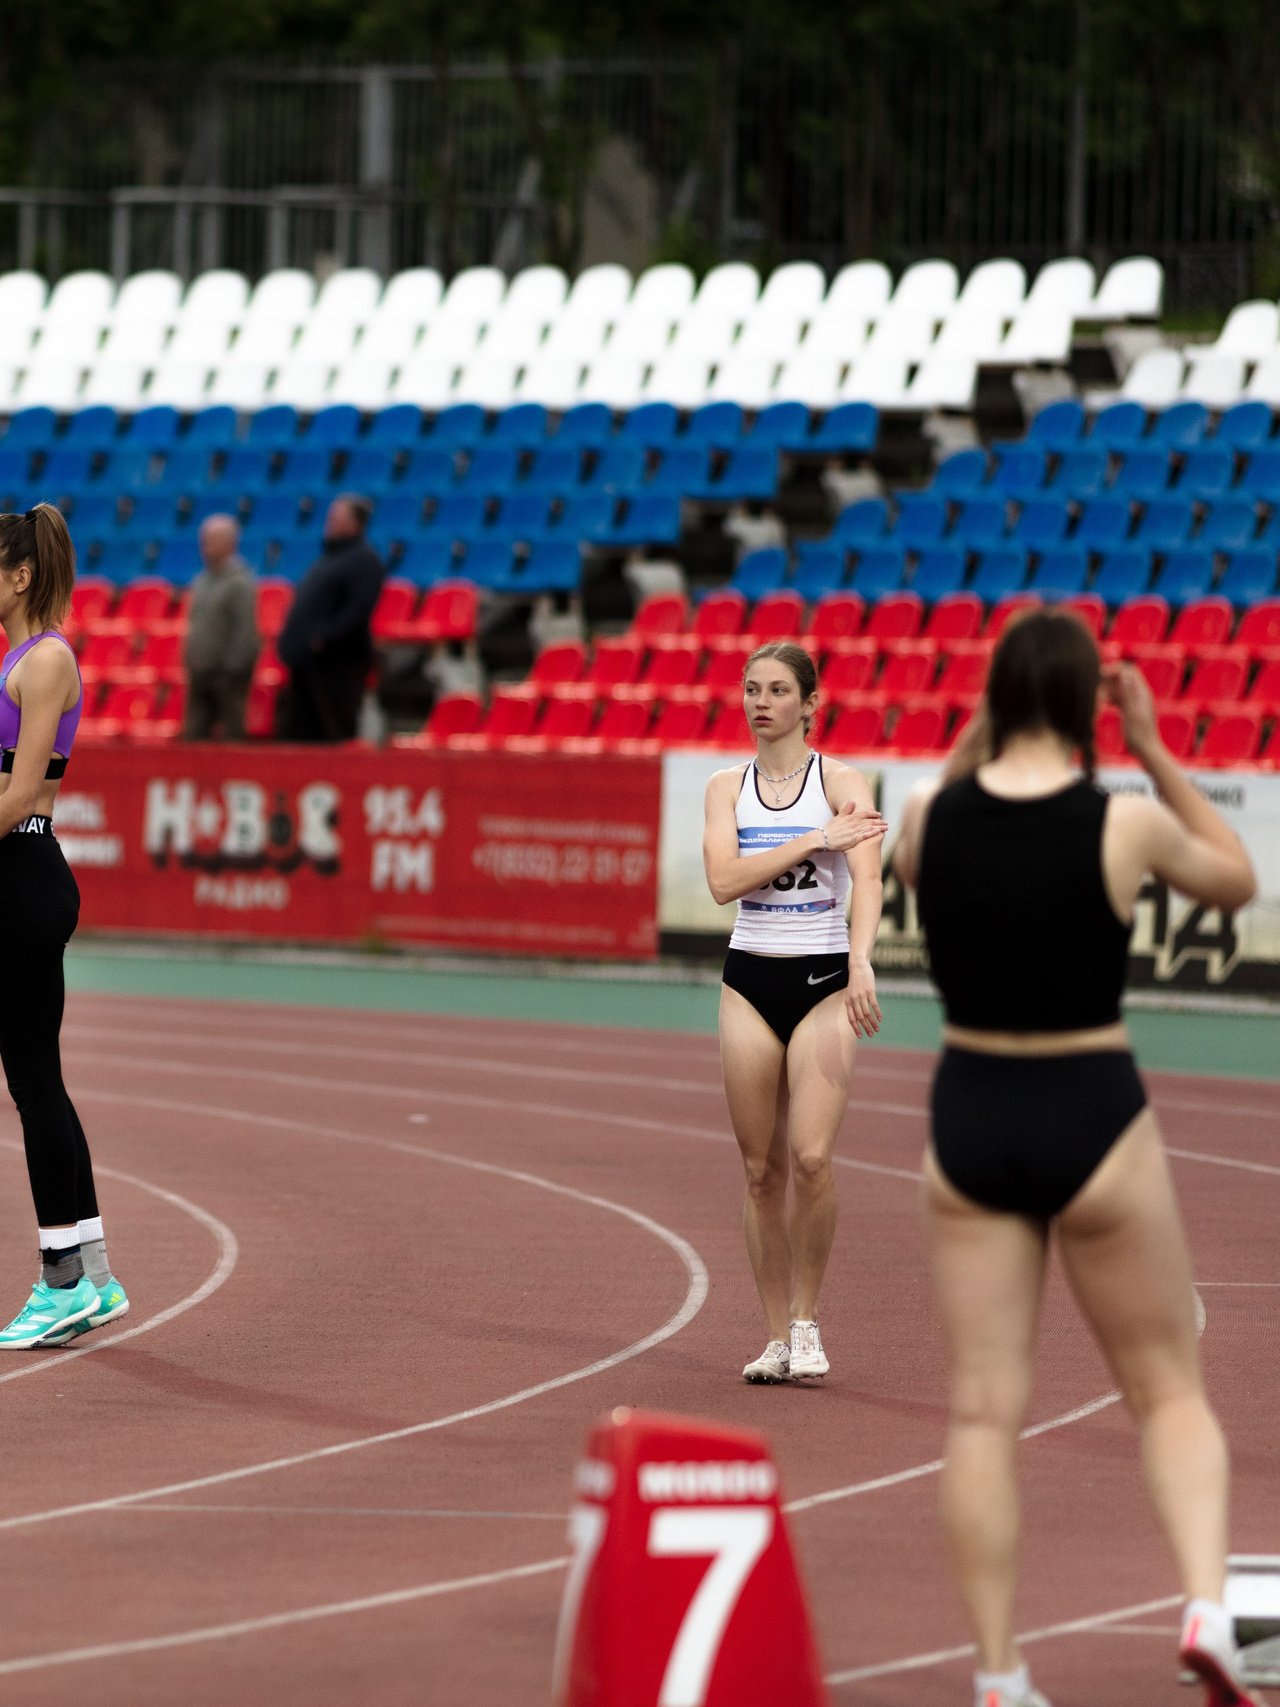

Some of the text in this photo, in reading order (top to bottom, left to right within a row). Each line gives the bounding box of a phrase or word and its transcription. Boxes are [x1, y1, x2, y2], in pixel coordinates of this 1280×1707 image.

[372, 841, 435, 893] FM
[761, 860, 818, 891] 62
[638, 1462, 778, 1501] MONDO
[646, 1505, 774, 1707] 7
